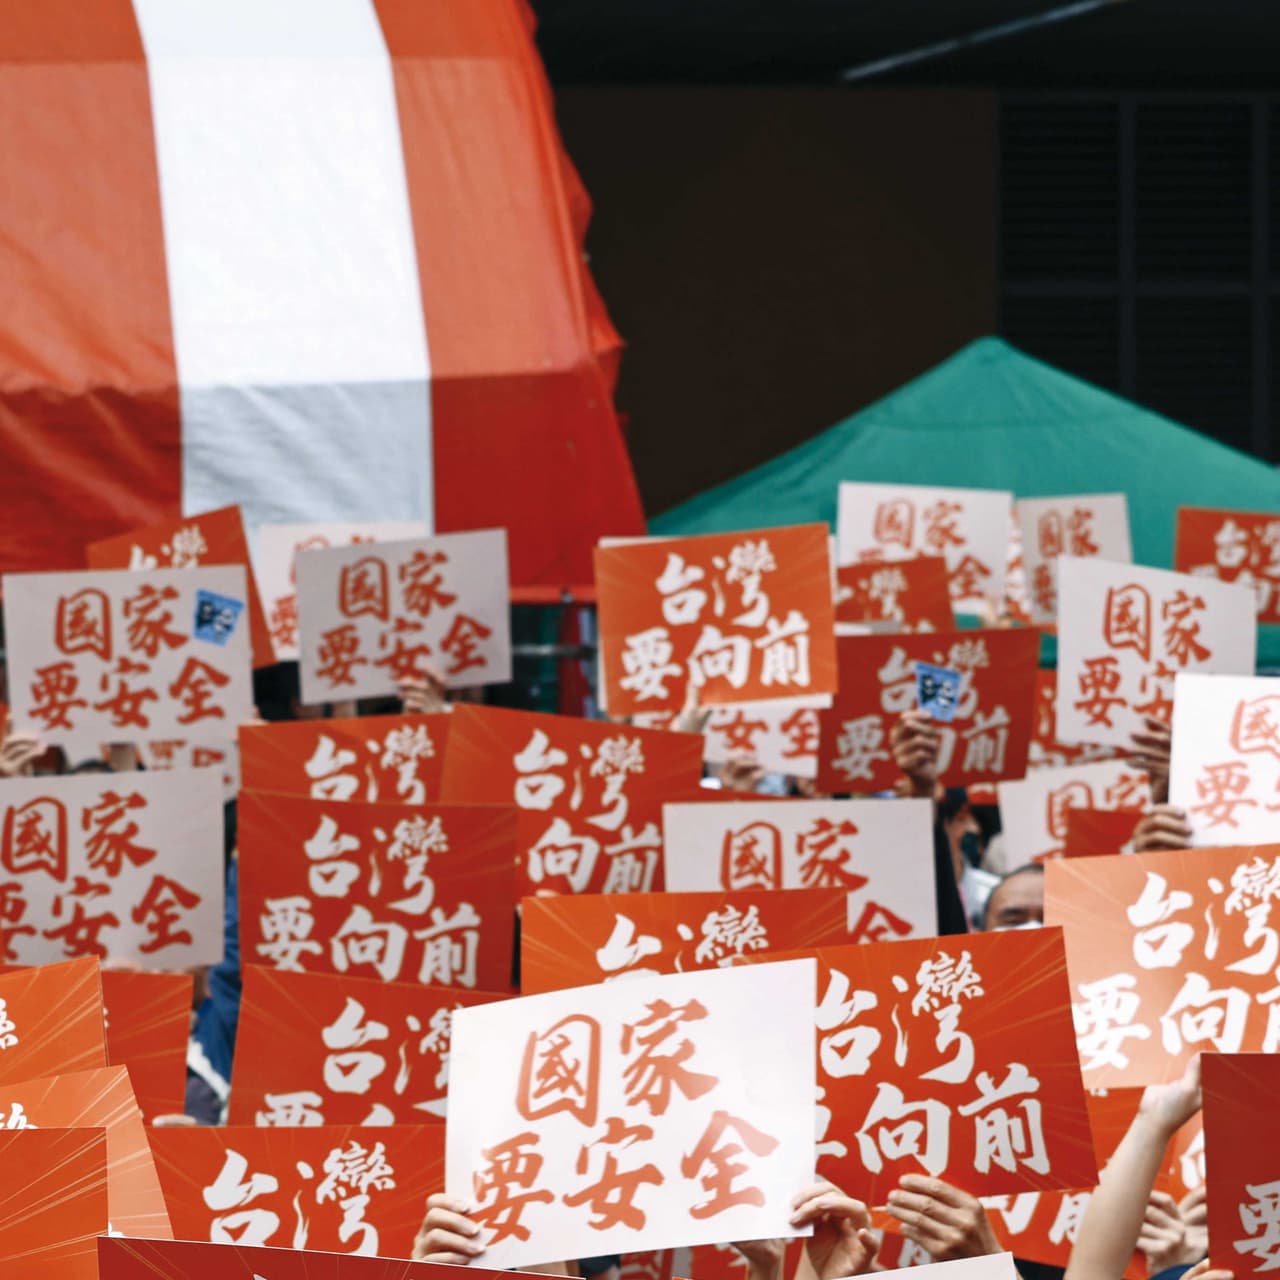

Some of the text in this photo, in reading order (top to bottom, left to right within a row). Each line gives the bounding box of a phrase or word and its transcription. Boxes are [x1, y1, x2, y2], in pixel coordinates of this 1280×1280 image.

[875, 499, 966, 549] 國家
[1039, 508, 1099, 558] 國家
[338, 551, 457, 621] 國家
[655, 539, 778, 626] 台灣
[837, 569, 909, 624] 灣
[1102, 582, 1212, 663] 國家
[55, 584, 188, 662] 國家
[316, 615, 493, 688] 要安全
[620, 610, 811, 701] 要向前
[29, 657, 231, 729] 要安全
[1075, 656, 1176, 727] 要安
[304, 725, 436, 805] 台灣
[513, 729, 645, 831] 台灣
[0, 791, 157, 883] 國家
[303, 815, 449, 915] 台灣
[528, 817, 662, 893] 向前
[720, 817, 869, 892] 國家
[256, 896, 482, 988] 要向前
[815, 950, 985, 1083] 台灣
[516, 998, 721, 1129] 國家
[202, 1140, 396, 1259] 台灣
[469, 1111, 781, 1247] 要安全
